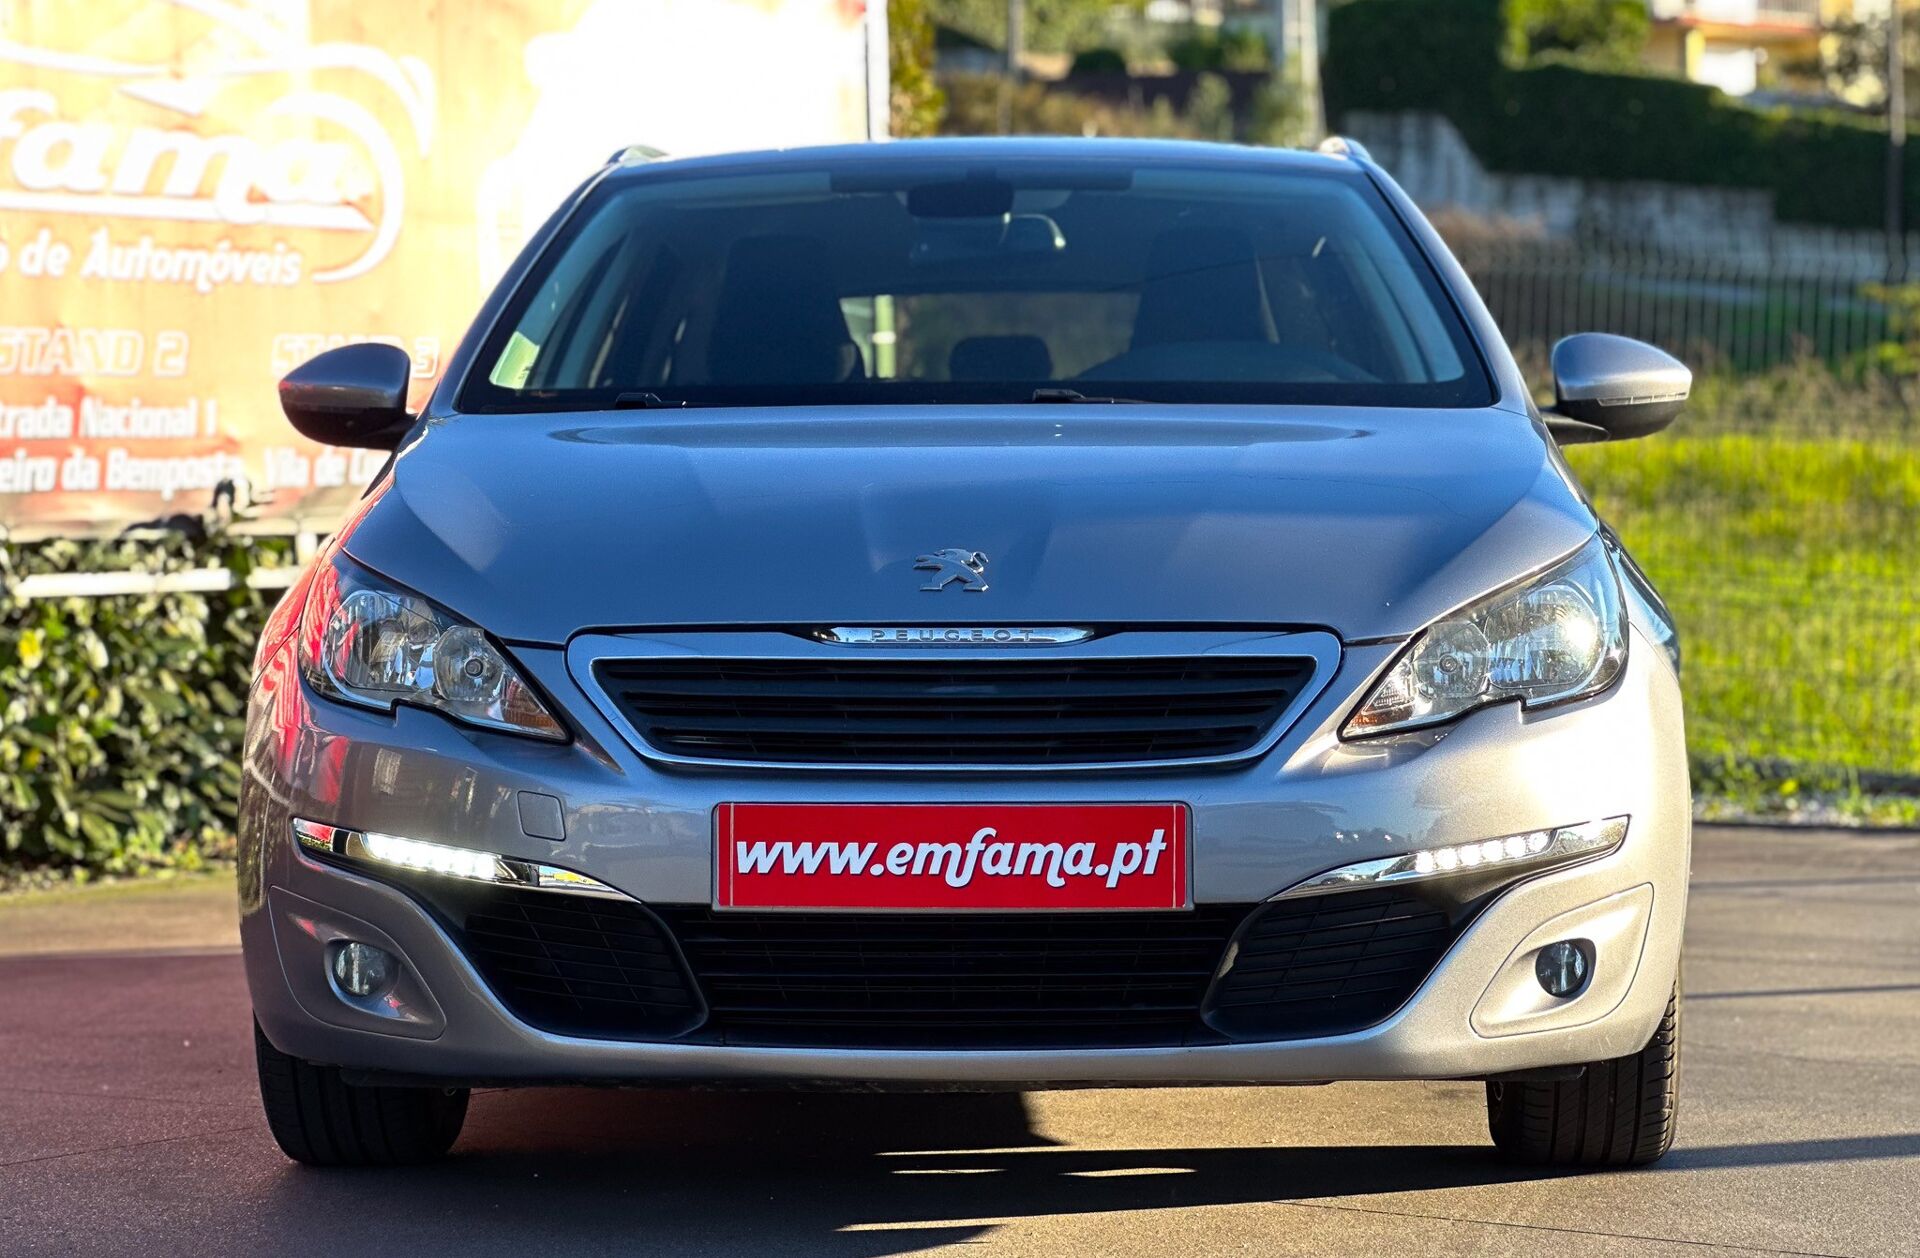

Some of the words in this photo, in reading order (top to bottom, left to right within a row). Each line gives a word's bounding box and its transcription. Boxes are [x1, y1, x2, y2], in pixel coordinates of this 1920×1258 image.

[19, 228, 71, 277] de
[153, 330, 189, 378] 2
[78, 395, 199, 439] Nacional
[61, 446, 100, 490] da
[313, 446, 347, 487] de
[870, 628, 1034, 642] PEUGEOT
[736, 827, 1167, 888] www.emfama.pt
